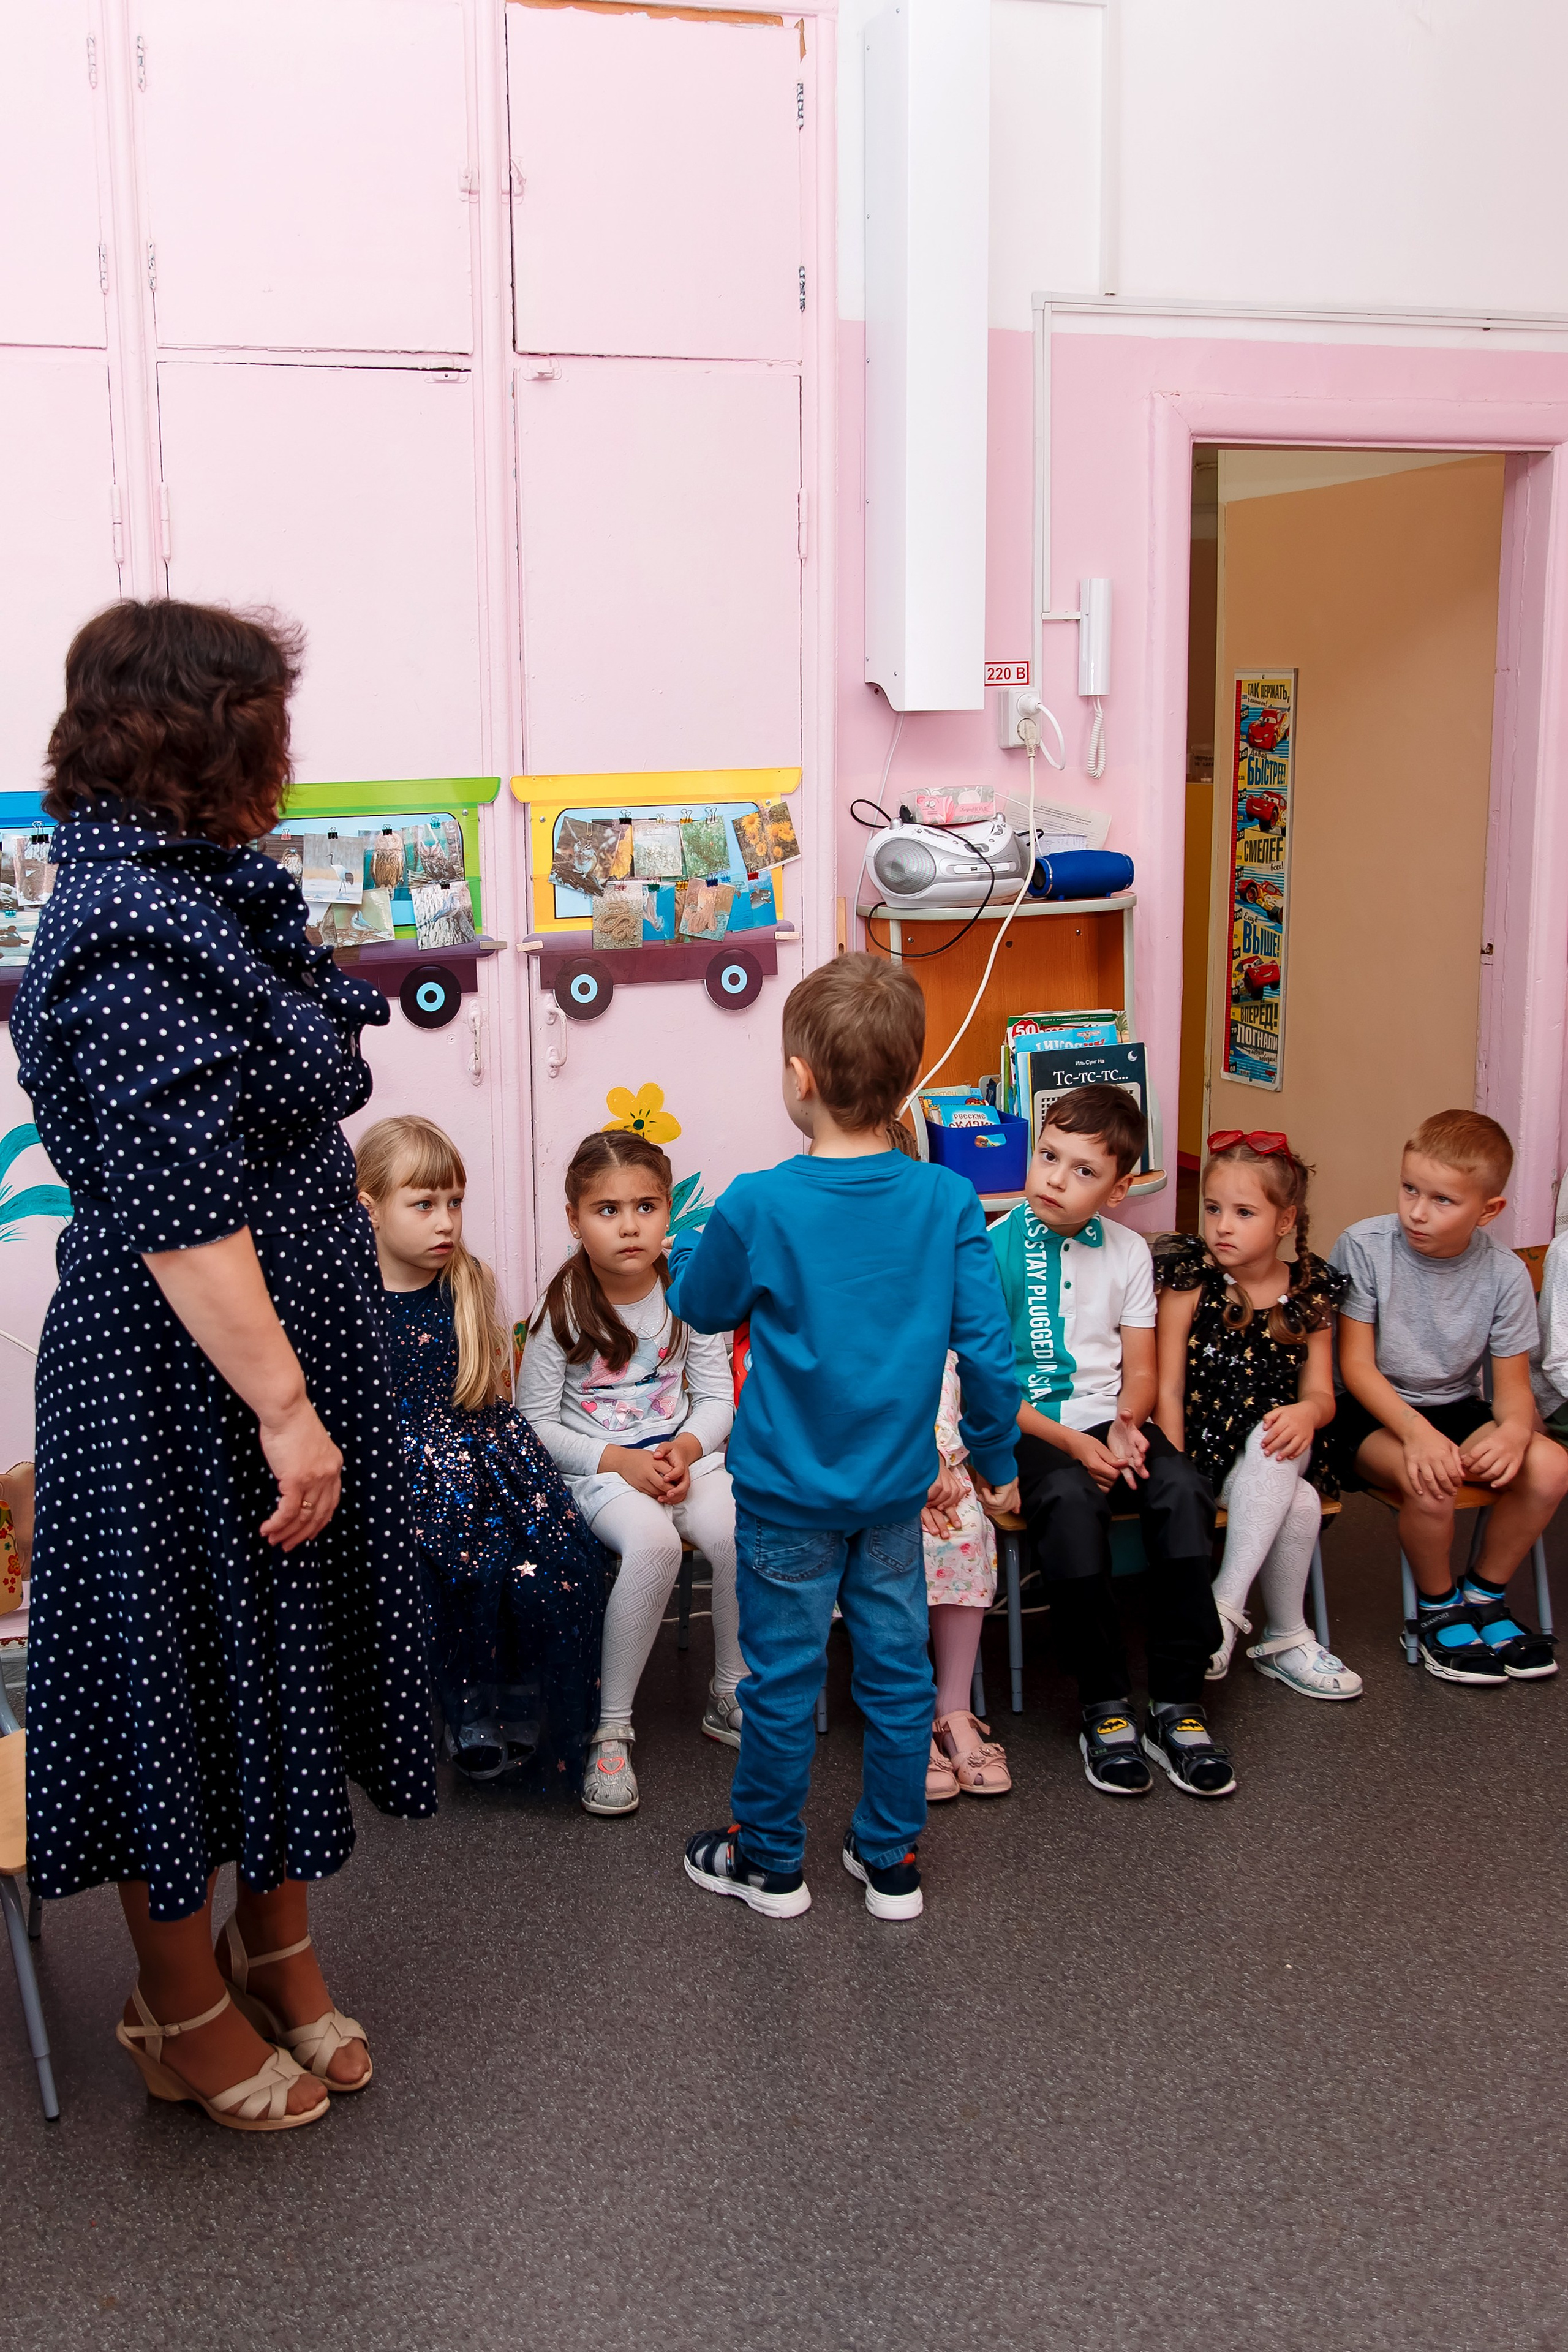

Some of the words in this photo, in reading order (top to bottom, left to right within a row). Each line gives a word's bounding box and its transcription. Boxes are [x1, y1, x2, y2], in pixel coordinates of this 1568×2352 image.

[987, 667, 1011, 680] 220
[1248, 682, 1260, 698] ТАК
[1247, 755, 1286, 785] БЫСТРЕЕ!
[1243, 920, 1280, 958] ВЫШЕ!
[1016, 1023, 1036, 1035] 50
[1240, 1000, 1278, 1031] ВПЕРЁД!
[1236, 1023, 1278, 1051] ПОГНАЛИ
[1025, 1240, 1047, 1281] STAY
